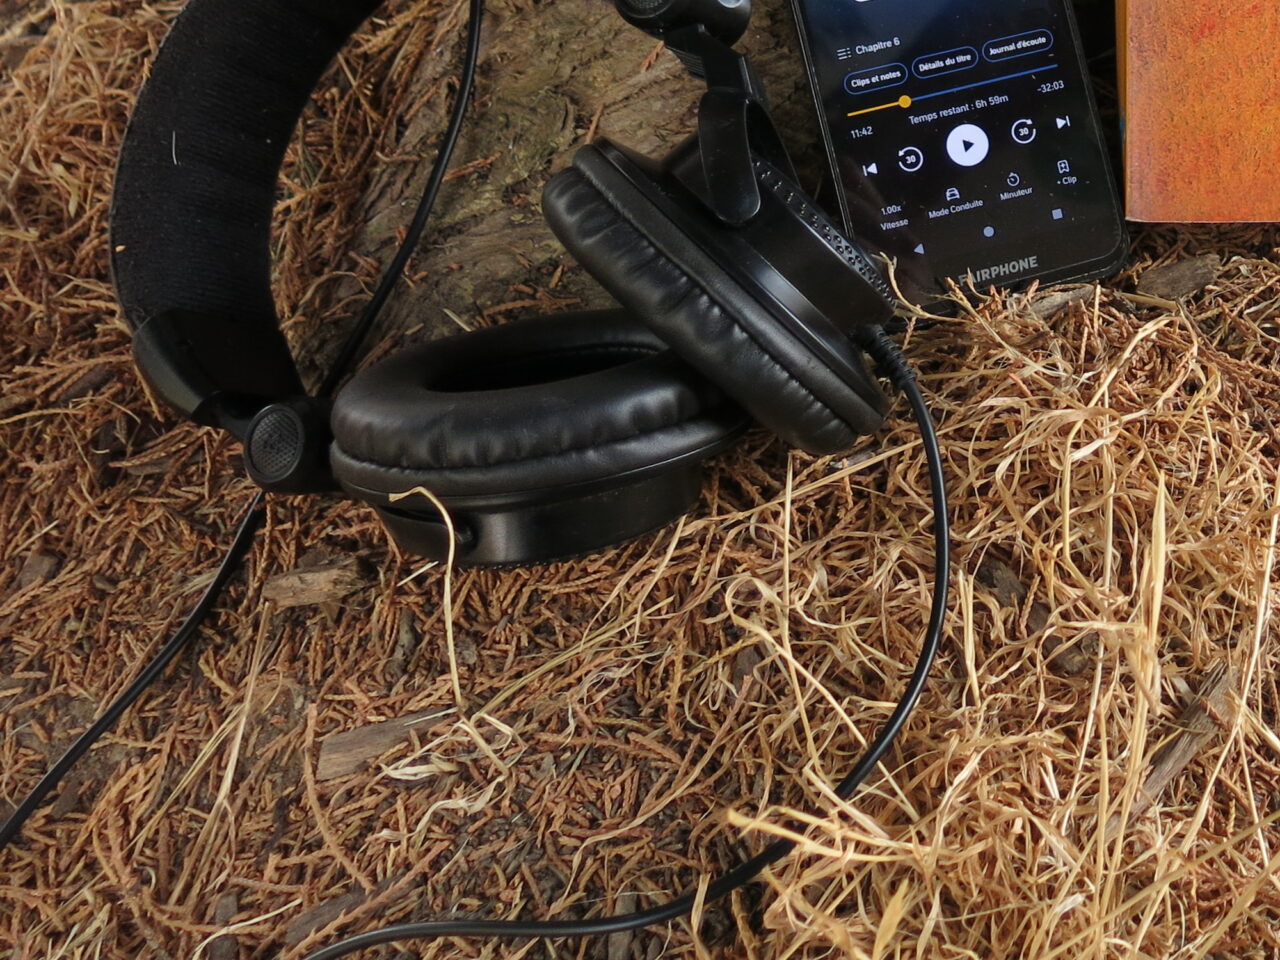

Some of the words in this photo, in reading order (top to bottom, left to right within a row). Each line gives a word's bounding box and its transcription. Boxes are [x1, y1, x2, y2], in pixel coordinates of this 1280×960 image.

[855, 40, 891, 55] Chapitre
[893, 36, 900, 46] 6
[989, 43, 1016, 56] Journal
[919, 57, 941, 72] Détails
[943, 57, 955, 68] du
[956, 52, 971, 65] titre
[851, 75, 870, 89] Clips
[871, 75, 879, 83] et
[880, 70, 901, 82] notes
[1037, 80, 1065, 93] -32:03
[909, 110, 938, 126] Temps
[939, 103, 969, 119] restant
[975, 98, 987, 111] 6h
[989, 93, 1009, 107] 59m
[850, 126, 873, 139] 11:42
[1018, 127, 1029, 136] 30
[906, 154, 916, 164] 30
[1062, 175, 1077, 185] Clip
[1000, 186, 1033, 200] Minuteur
[881, 204, 902, 215] 1.00x
[928, 205, 949, 219] Mode
[950, 198, 983, 214] Conduite
[880, 217, 909, 231] Vitesse
